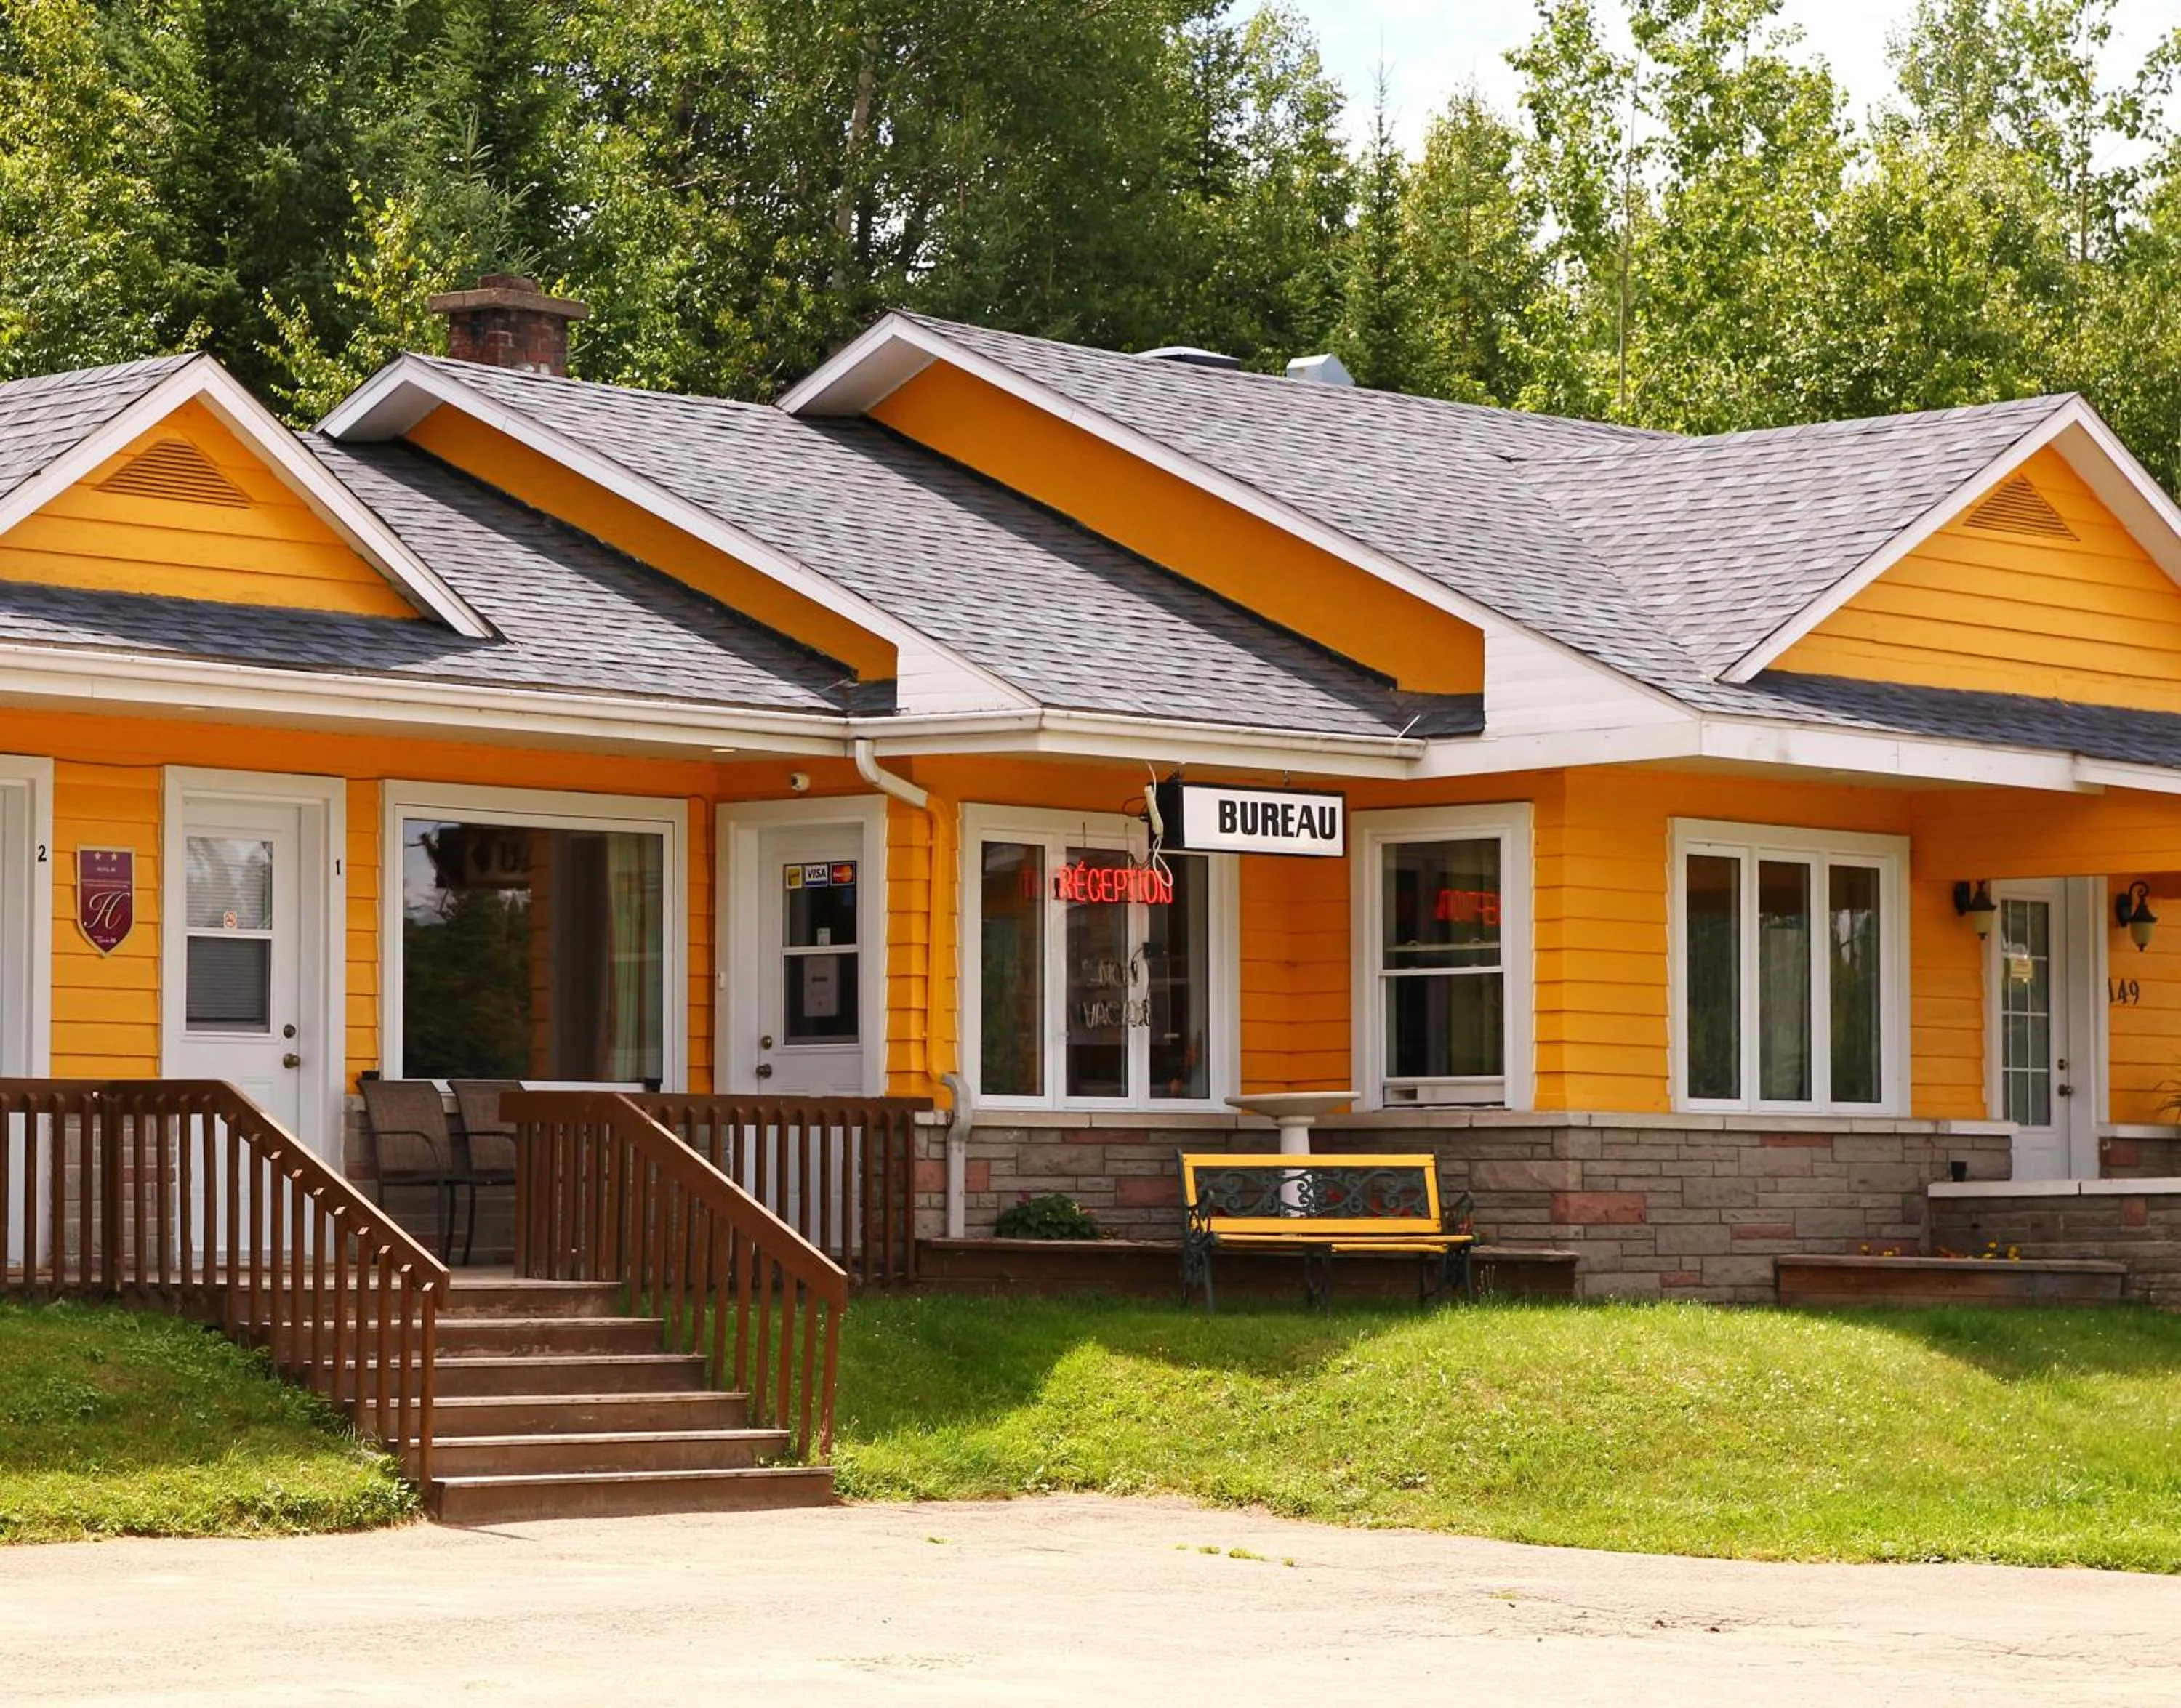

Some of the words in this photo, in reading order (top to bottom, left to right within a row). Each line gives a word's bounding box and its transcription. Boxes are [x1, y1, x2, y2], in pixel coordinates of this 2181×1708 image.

[1219, 800, 1336, 839] BUREAU
[38, 845, 47, 862] 2
[336, 859, 340, 875] 1
[806, 868, 827, 879] VISA
[1059, 860, 1173, 903] RÉCEPTION
